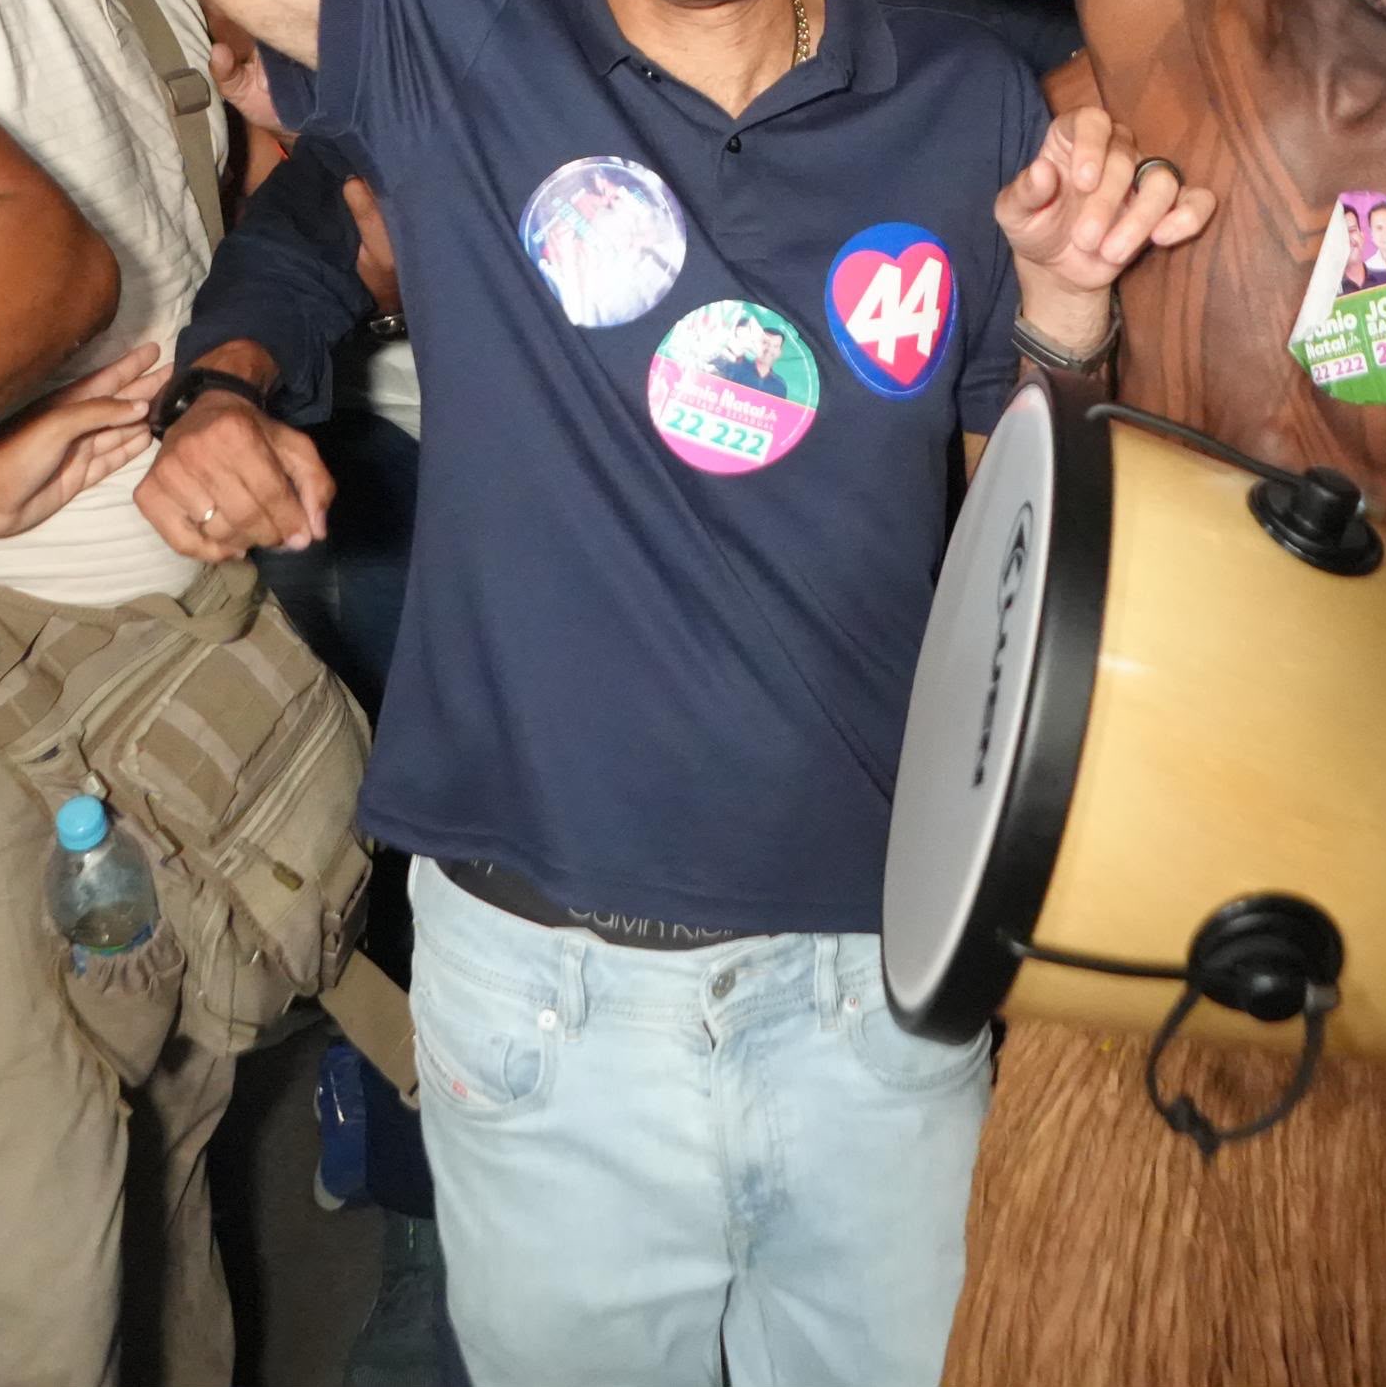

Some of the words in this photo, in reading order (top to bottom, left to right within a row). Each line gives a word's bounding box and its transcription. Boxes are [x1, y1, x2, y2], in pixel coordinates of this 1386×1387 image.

[845, 256, 942, 365] 44
[1314, 364, 1330, 382] 22
[1333, 356, 1364, 376] 222
[666, 406, 705, 438] 22
[710, 420, 766, 457] 222
